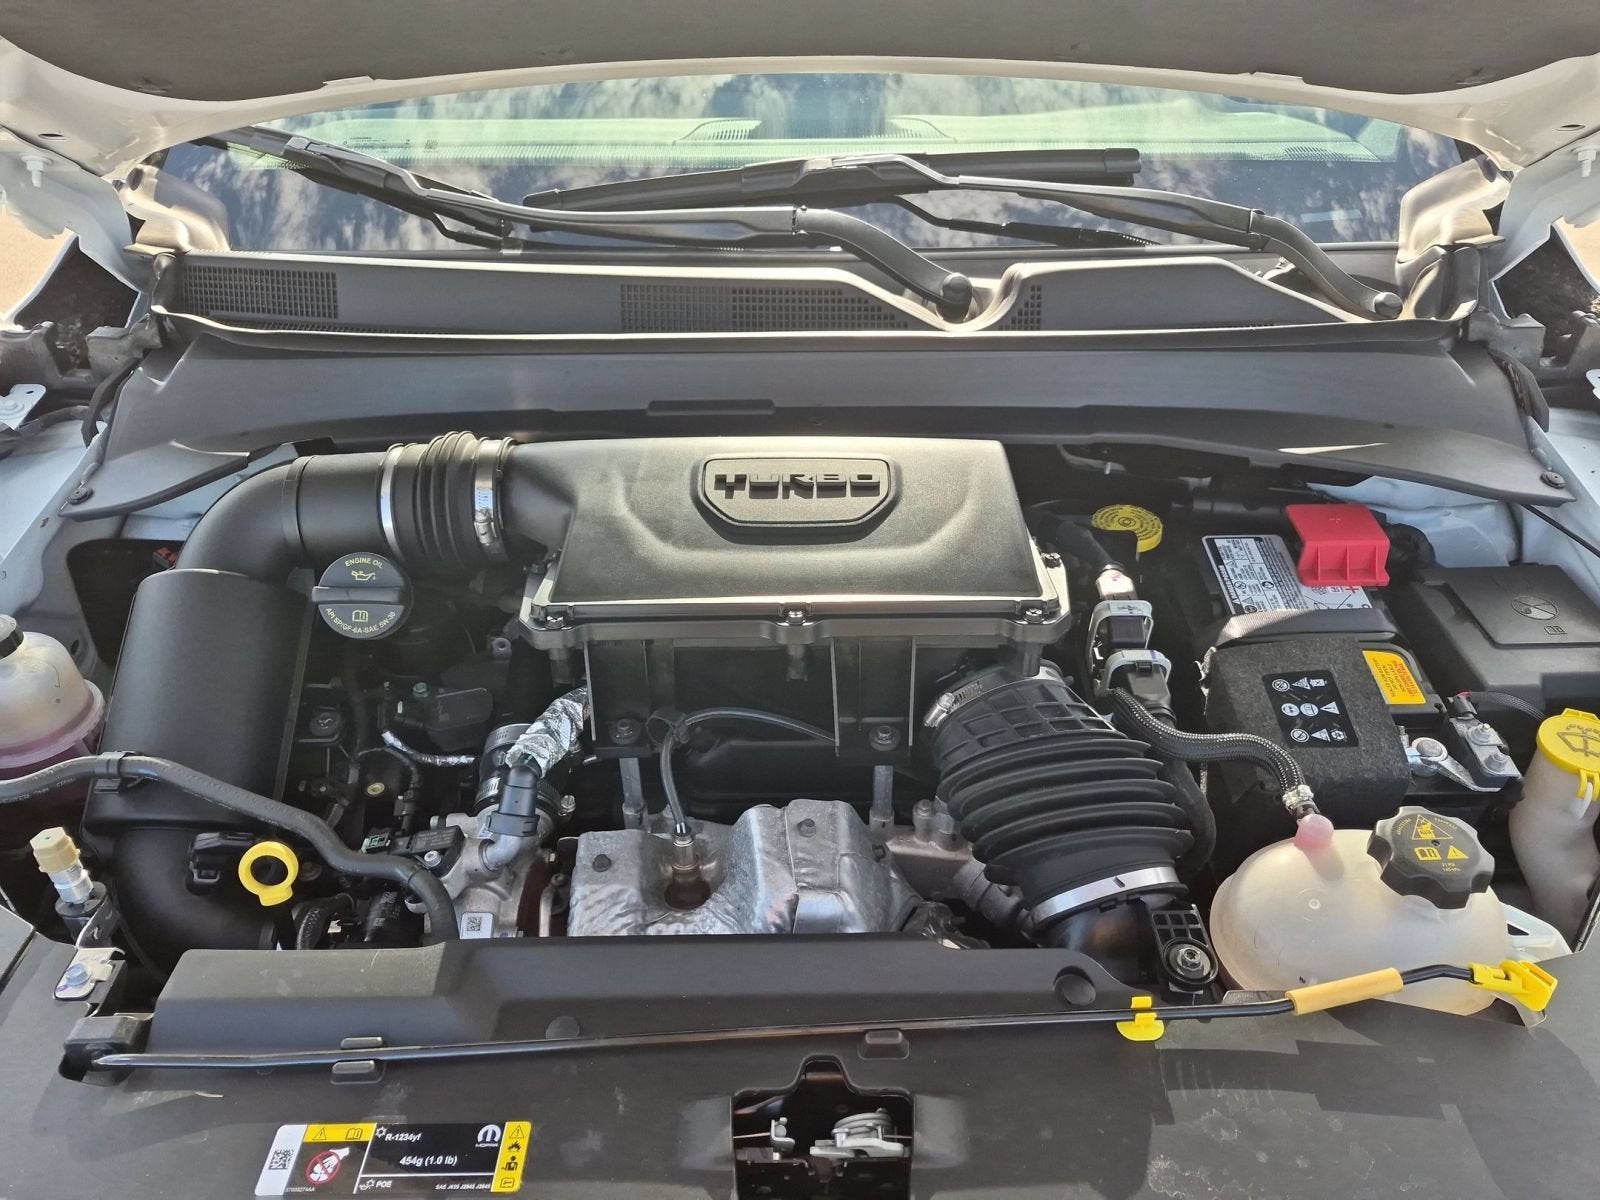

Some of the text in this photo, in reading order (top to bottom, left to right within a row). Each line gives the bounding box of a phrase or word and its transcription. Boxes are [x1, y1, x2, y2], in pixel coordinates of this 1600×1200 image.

[713, 473, 881, 499] TURBO
[344, 557, 384, 569] ENGINE OIL
[325, 608, 335, 619] API
[379, 611, 396, 628] 5W-30
[385, 1132, 421, 1142] R-1234yf
[399, 1155, 458, 1166] 454g (1.0 lb)
[375, 1180, 392, 1188] POE
